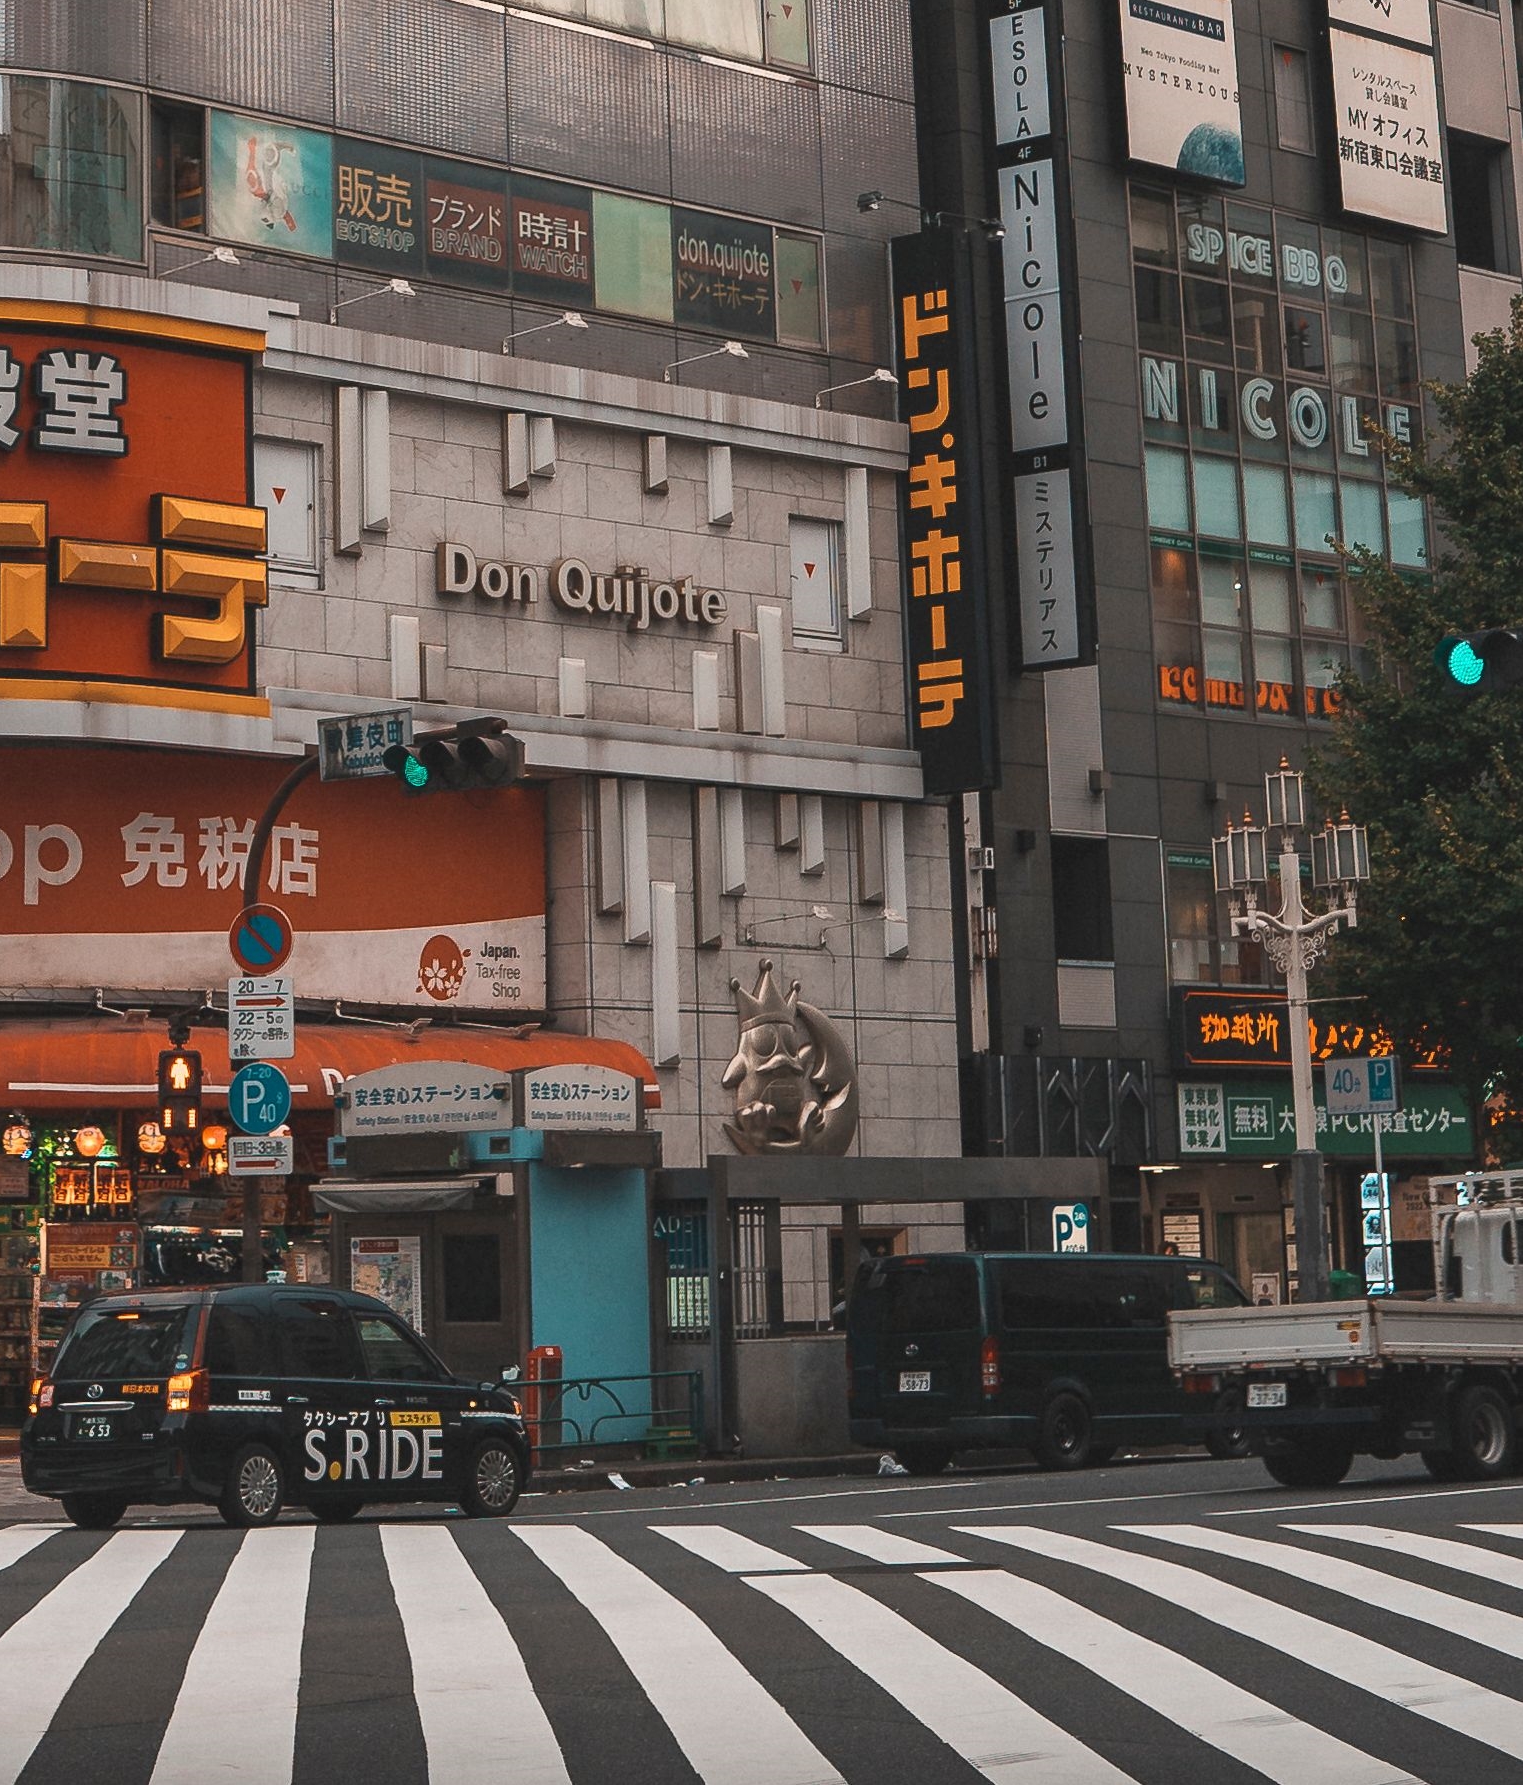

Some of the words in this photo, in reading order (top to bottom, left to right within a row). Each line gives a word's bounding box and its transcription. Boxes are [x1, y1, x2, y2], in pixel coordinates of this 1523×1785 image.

[1132, 4, 1189, 28] RESTAURANT
[1198, 20, 1222, 36] BAR
[1141, 46, 1153, 57] Neo
[1156, 51, 1177, 63] Tokyo
[1124, 61, 1240, 103] MYSTERIOUS
[1353, 67, 1417, 96] レンタルスペース
[1348, 106, 1368, 130] MY
[1373, 114, 1428, 148] オフィス
[1018, 146, 1032, 160] 4F
[1339, 135, 1443, 184] 新宿東口会議室
[339, 165, 413, 227] 販売
[430, 195, 501, 235] ブランド
[519, 212, 587, 252] 時計
[432, 228, 502, 262] BRAND
[519, 243, 588, 280] WATCH
[678, 228, 769, 280] don.quijote
[1186, 223, 1273, 277] SPICE
[1282, 244, 1348, 293] BBQ
[1014, 170, 1048, 420] Nicole
[1141, 356, 1411, 460] NICOLE
[1033, 455, 1047, 468] B1
[1034, 480, 1058, 653] ミステリアス
[436, 541, 539, 602] Don
[550, 557, 728, 629] Quijote
[120, 812, 320, 897] 免税店
[480, 942, 520, 961] Japan.
[476, 963, 520, 980] Tax-free
[492, 982, 520, 999] Shop
[1201, 1013, 1279, 1053] 珈琲所
[531, 1082, 629, 1102] 安全安心ステーション
[1374, 1063, 1387, 1086] P
[243, 1080, 265, 1123] P
[355, 1083, 498, 1107] 安全安心ステーション
[259, 1104, 276, 1123] 40
[1185, 1109, 1220, 1127] 無料化
[1235, 1106, 1268, 1132] 無料
[1279, 1106, 1467, 1134] 大模PCR検査センター
[1055, 1214, 1072, 1252] P
[304, 1411, 385, 1426] タクシーアプリ
